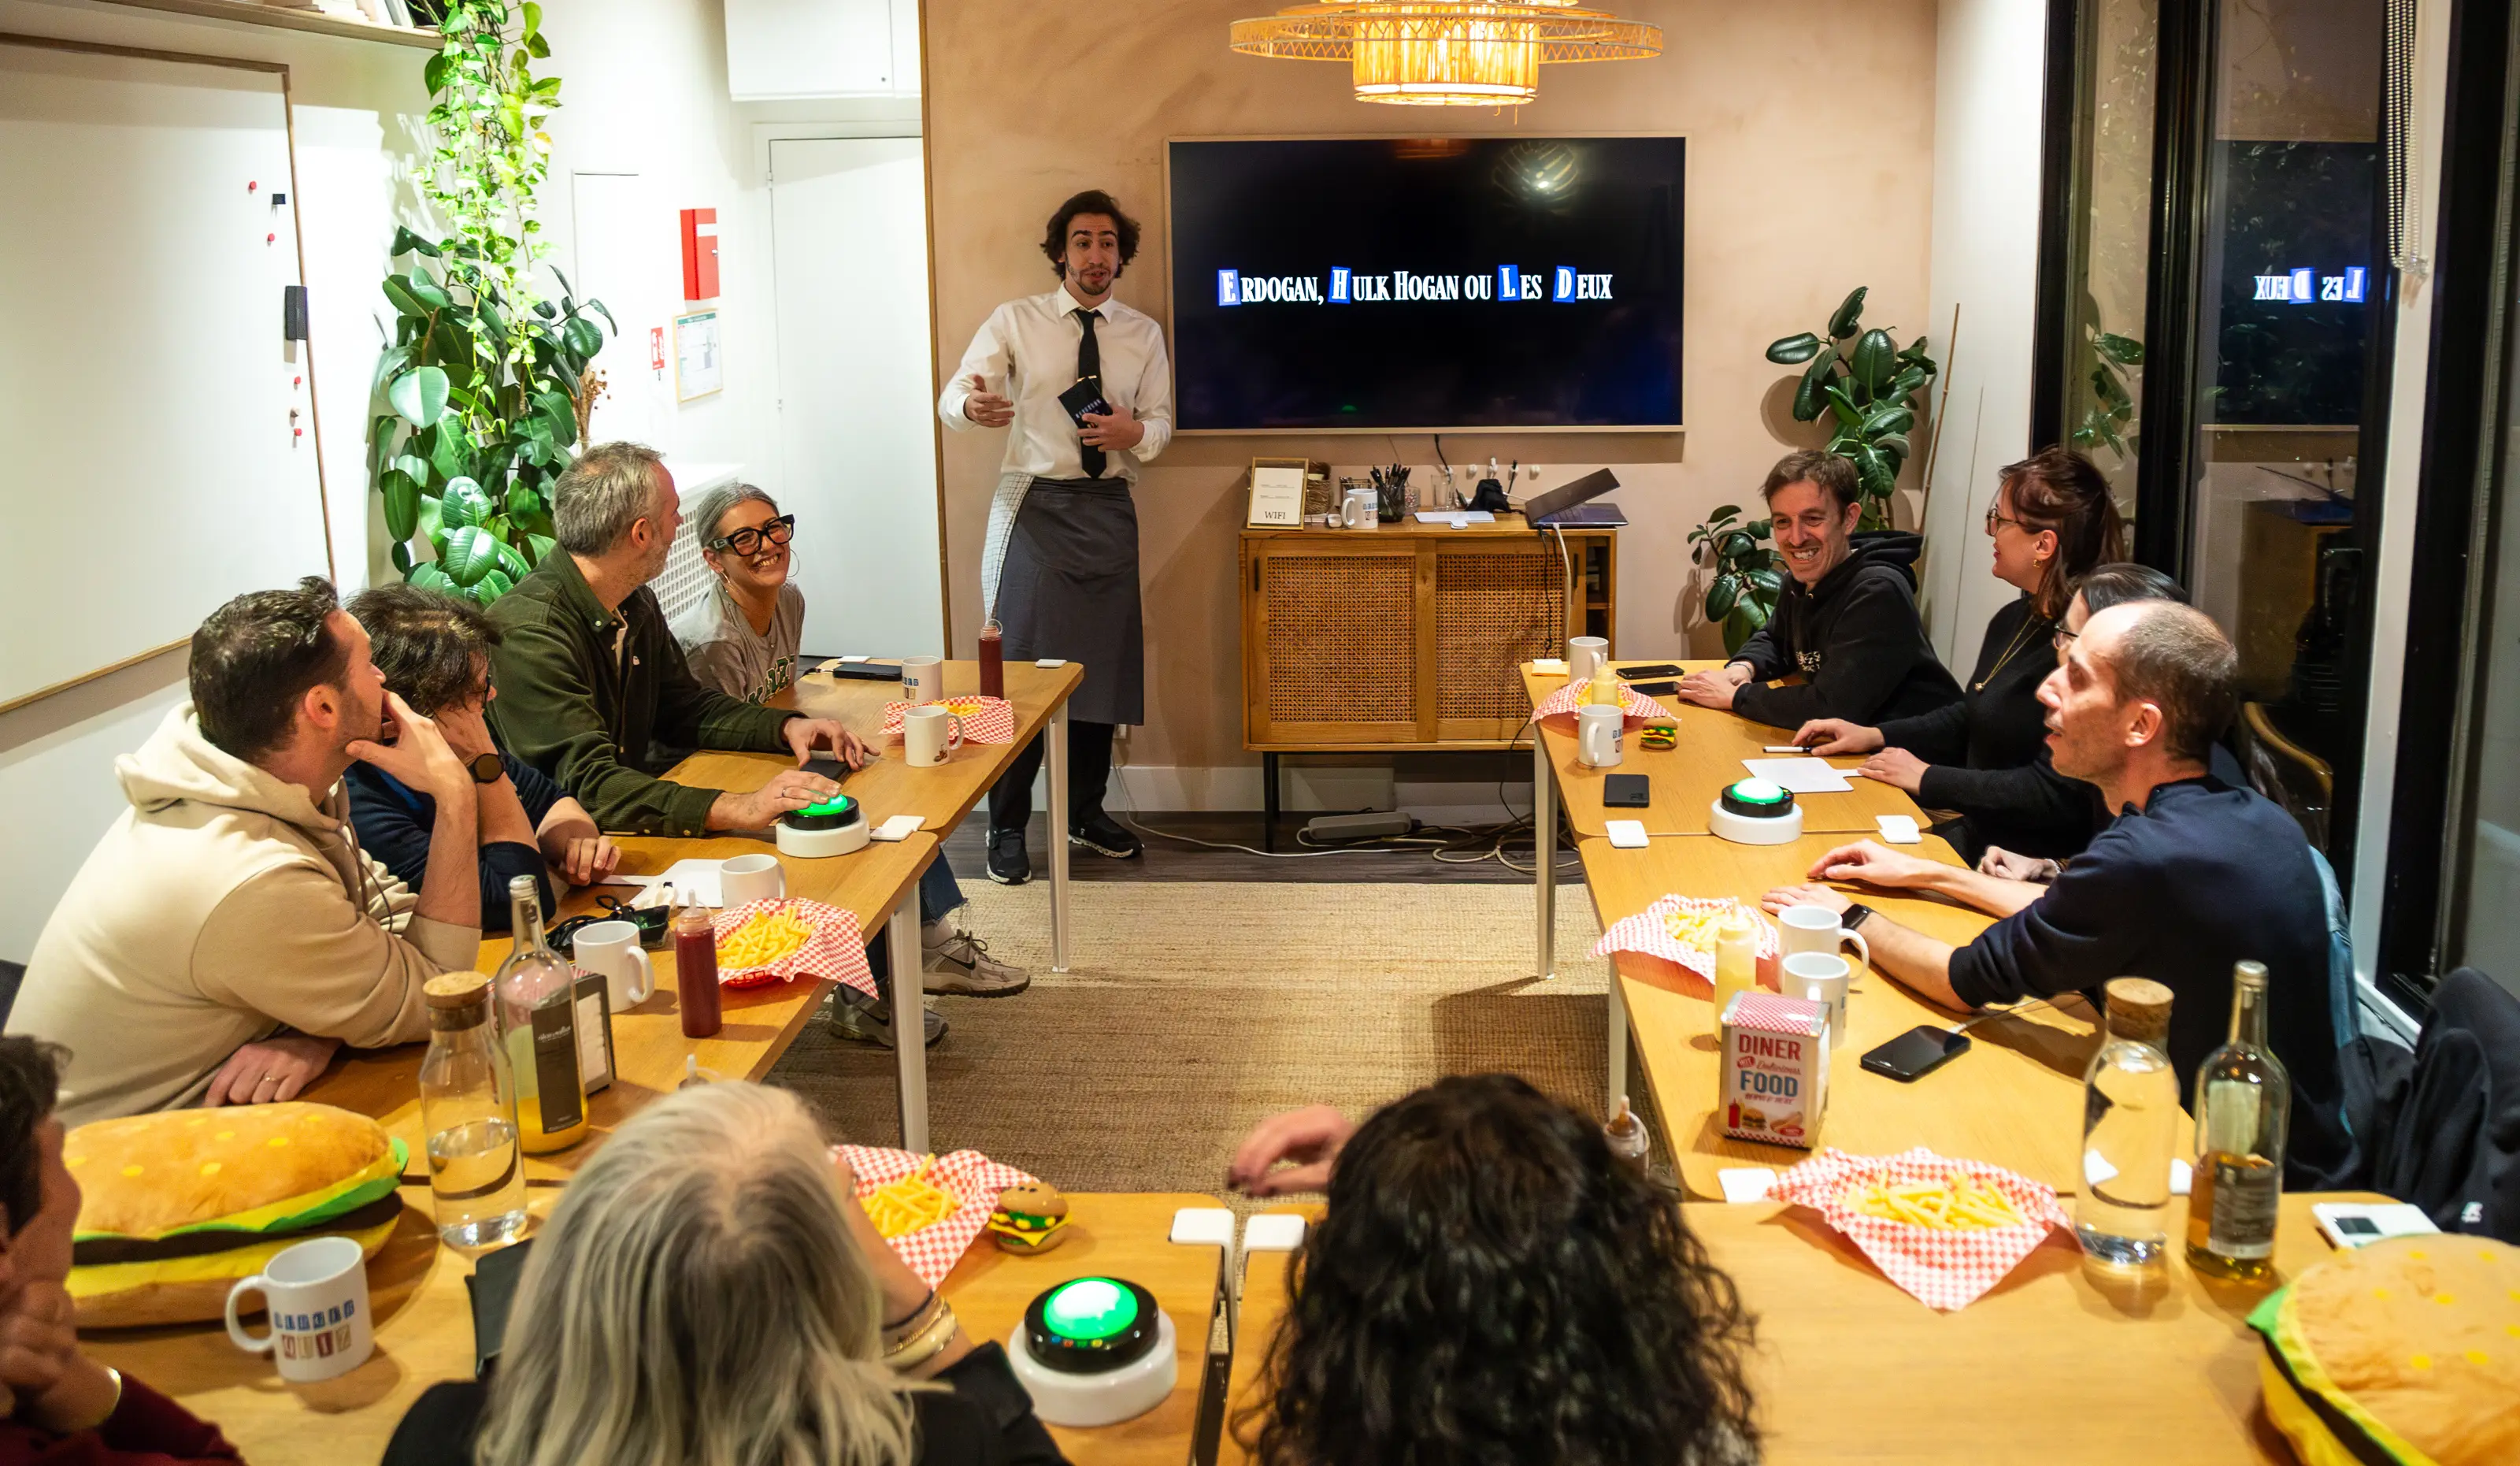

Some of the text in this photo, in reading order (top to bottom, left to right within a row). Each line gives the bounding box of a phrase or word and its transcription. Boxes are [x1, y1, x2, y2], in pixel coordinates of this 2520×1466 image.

[1331, 267, 1391, 302] HULK
[1395, 271, 1458, 301] HOGAN
[1465, 275, 1491, 300] OU
[1500, 266, 1542, 300] LES
[1556, 266, 1614, 301] DEUX
[1264, 511, 1286, 520] WIFI
[1739, 1034, 1802, 1062] DINER
[1740, 1070, 1799, 1097] FOOD
